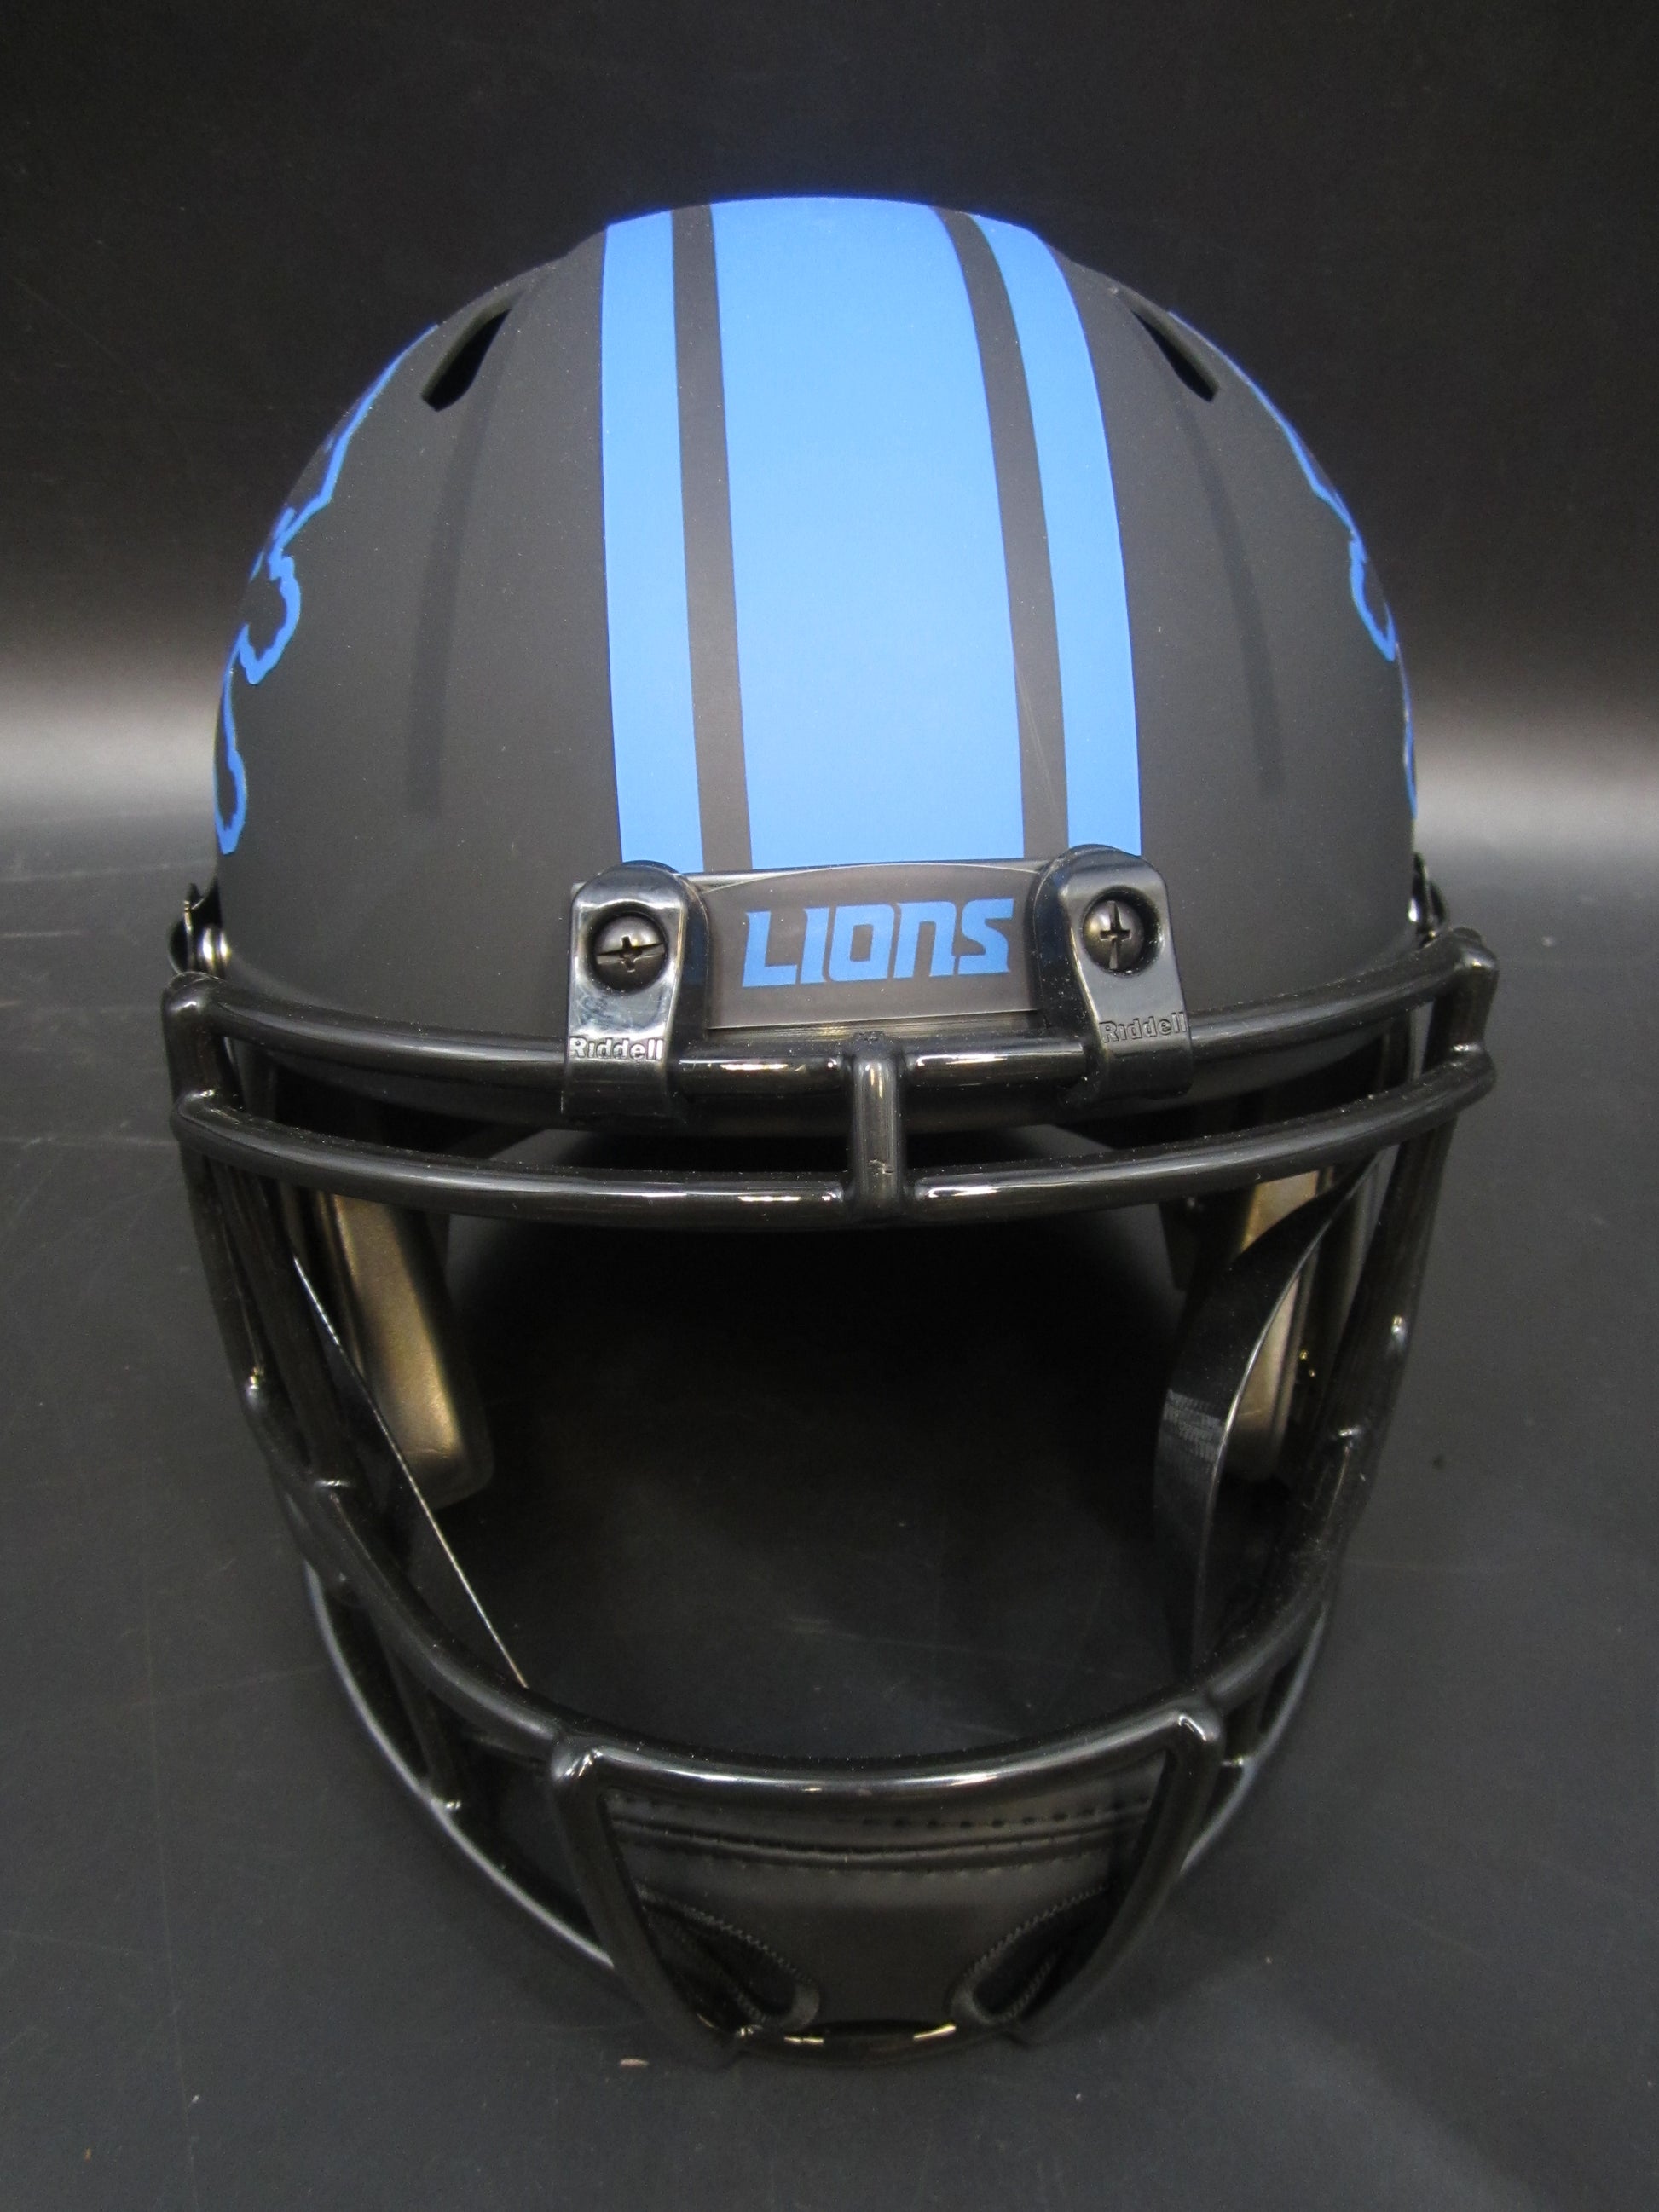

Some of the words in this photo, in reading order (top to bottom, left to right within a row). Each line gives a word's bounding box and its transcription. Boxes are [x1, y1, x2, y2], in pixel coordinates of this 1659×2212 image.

[743, 898, 1014, 988] LIONS
[1099, 1011, 1187, 1043] Riddell
[569, 1036, 663, 1060] Riddell
